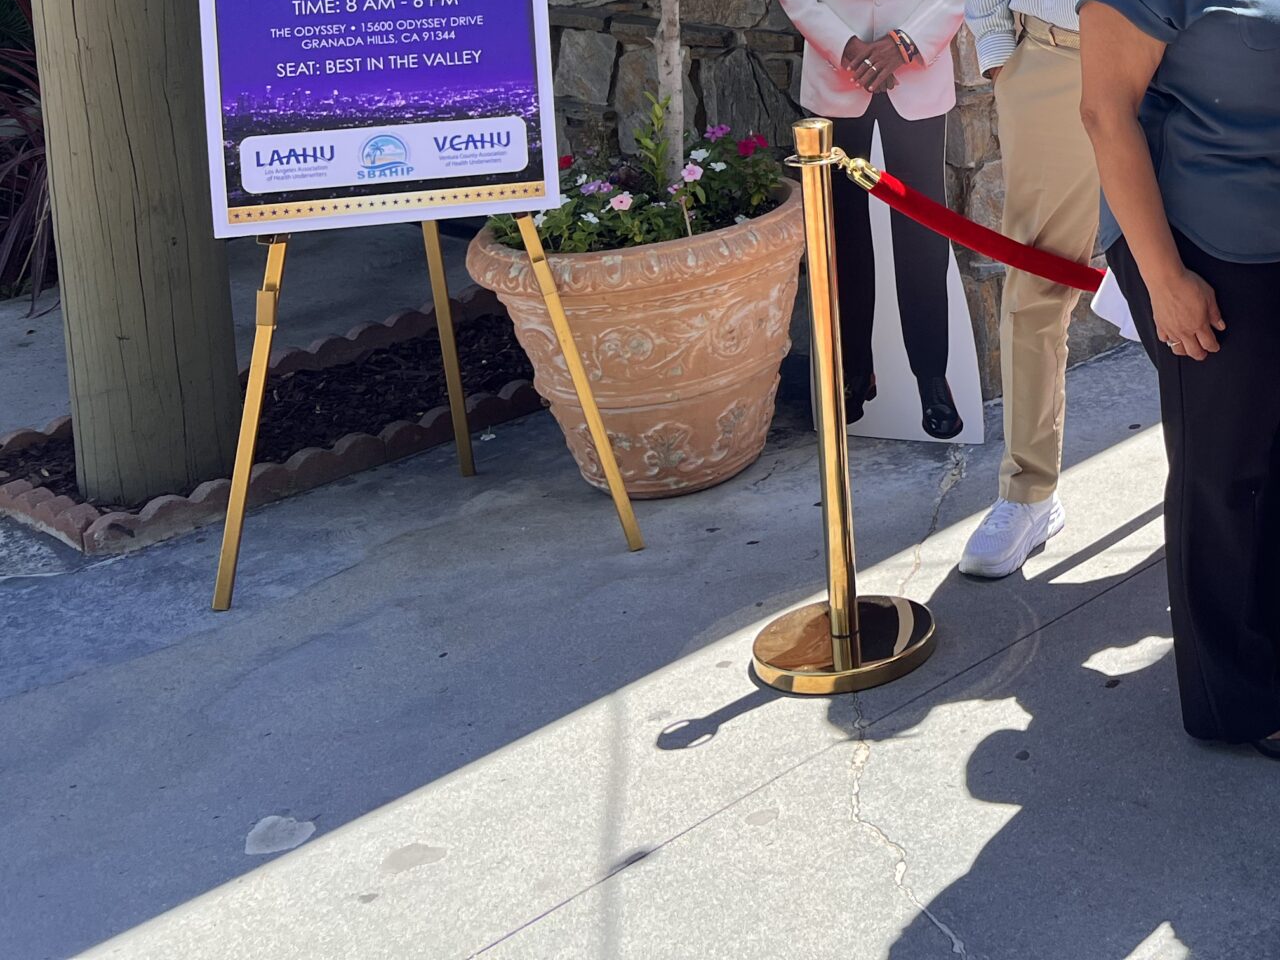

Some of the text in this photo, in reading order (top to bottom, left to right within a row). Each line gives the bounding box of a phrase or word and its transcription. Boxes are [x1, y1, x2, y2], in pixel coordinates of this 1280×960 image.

[270, 15, 484, 38] THE ODYSSEY 15600 ODYSSEY DRIVE
[301, 30, 456, 50] GRANADA HILLS, CA 91344
[276, 50, 482, 78] SEAT: BEST IN THE VALLEY
[433, 131, 511, 152] VCAHU
[255, 145, 335, 167] LAAHU
[357, 166, 415, 180] SBAHIP
